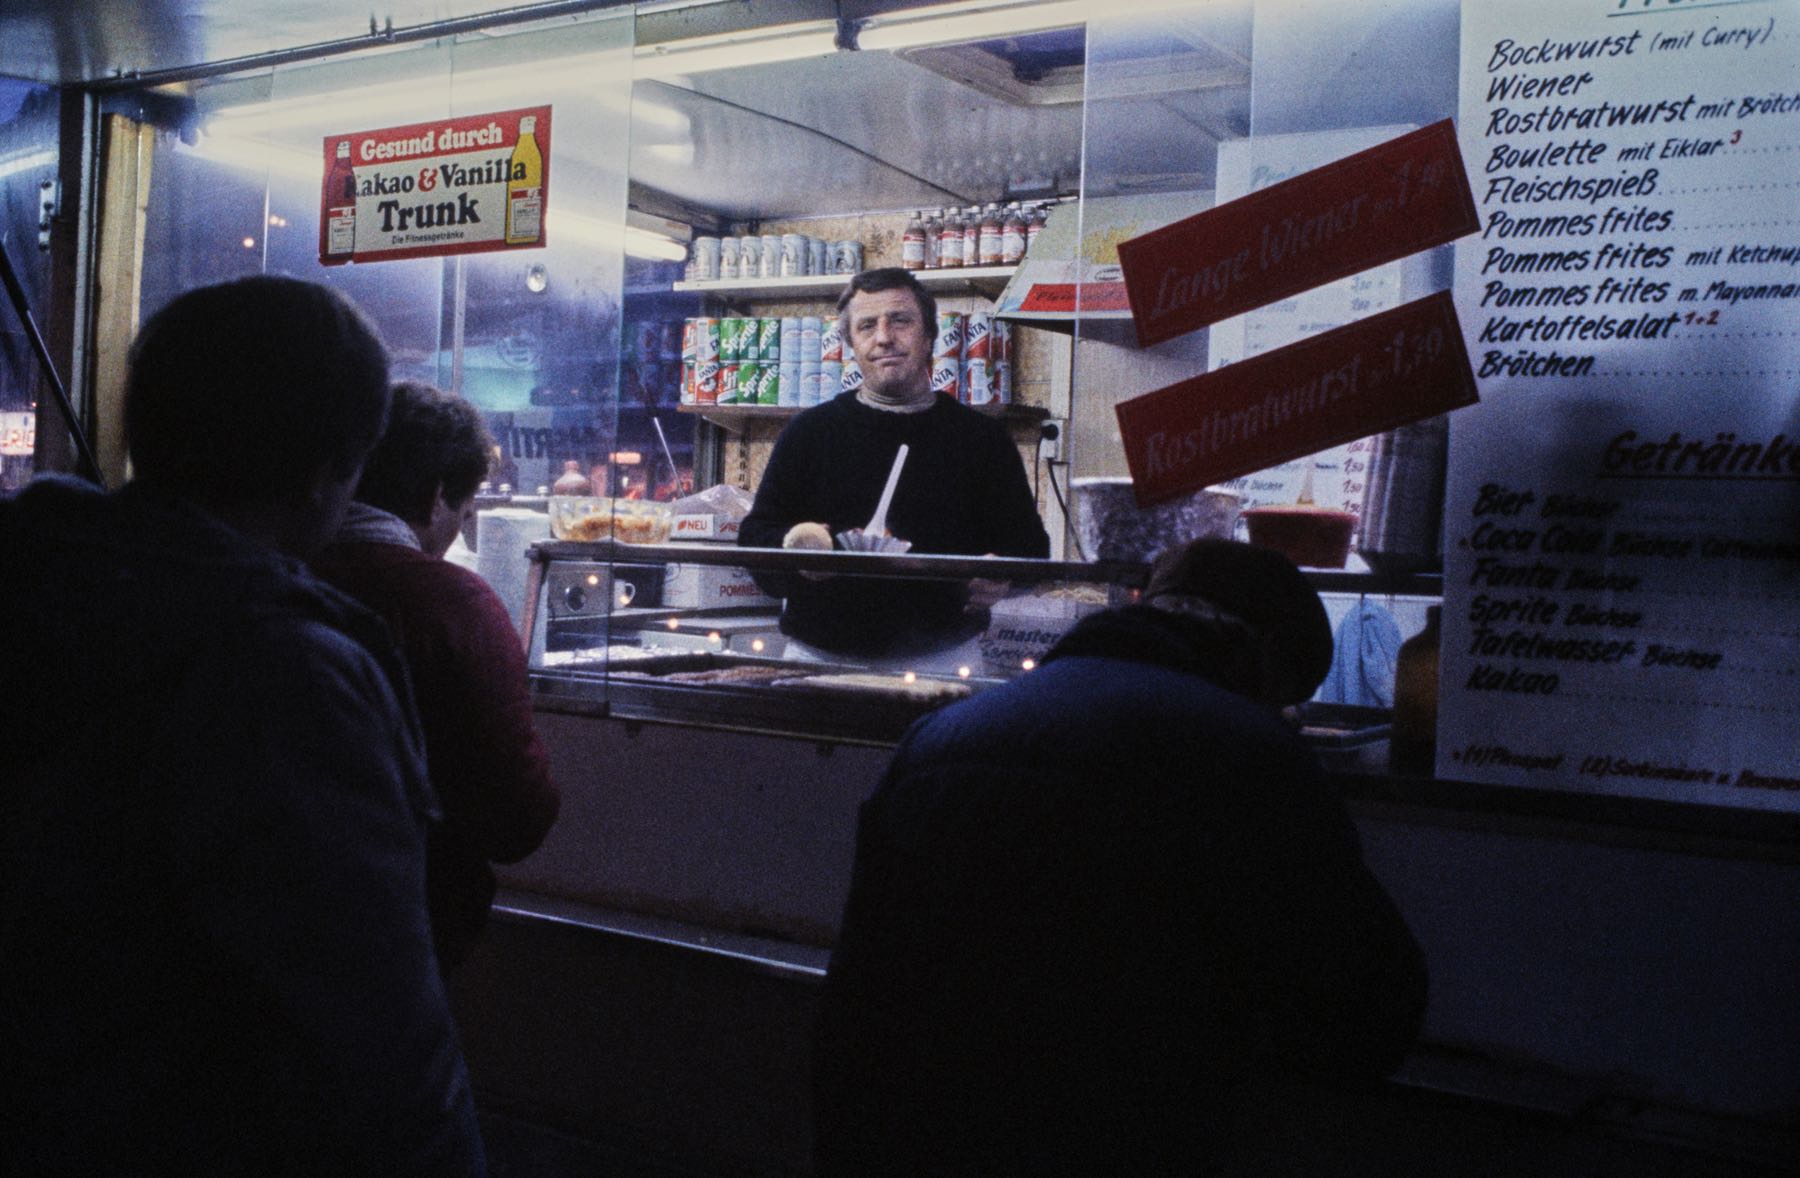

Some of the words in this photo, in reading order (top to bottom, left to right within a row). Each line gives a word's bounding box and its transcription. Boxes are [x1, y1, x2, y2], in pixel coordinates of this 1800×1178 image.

[1488, 30, 1642, 73] Bockwurst
[1650, 33, 1695, 53] (mit
[1701, 17, 1775, 48] Curry)
[1487, 72, 1593, 102] Wiener
[1486, 94, 1696, 137] Rostbratwurst
[1696, 98, 1735, 119] mit
[360, 132, 435, 161] Gesund
[438, 122, 503, 150] durch
[1486, 142, 1608, 173] Boulette
[1617, 143, 1656, 163] mit
[1660, 138, 1724, 160] Eiklar
[418, 167, 438, 192] &
[440, 158, 527, 189] Vanilla
[1484, 168, 1659, 205] Fleischspieß
[377, 193, 481, 233] Trunk
[1483, 210, 1597, 240] Pommes
[1598, 205, 1674, 235] frites
[1150, 247, 1250, 322] Lange
[1259, 191, 1369, 273] Wiener
[1481, 246, 1590, 275] Pommes
[1594, 242, 1674, 271] frites
[1685, 246, 1723, 266] mit
[1480, 281, 1591, 307] Pommes
[1594, 276, 1671, 304] frites
[1479, 313, 1681, 343] Kartoffelsalat
[1478, 350, 1594, 379] Brötchen
[1146, 356, 1361, 474] Rostbratwurst
[1473, 484, 1535, 517] Bier
[687, 519, 708, 531] NEU
[1472, 522, 1536, 551] Coca
[1541, 526, 1603, 553] Cola
[1469, 557, 1560, 589] Fanta
[1469, 595, 1560, 627] Sprite
[998, 628, 1061, 645] master
[1470, 628, 1636, 663] Tafelwasser
[1467, 665, 1559, 695] Kakao
